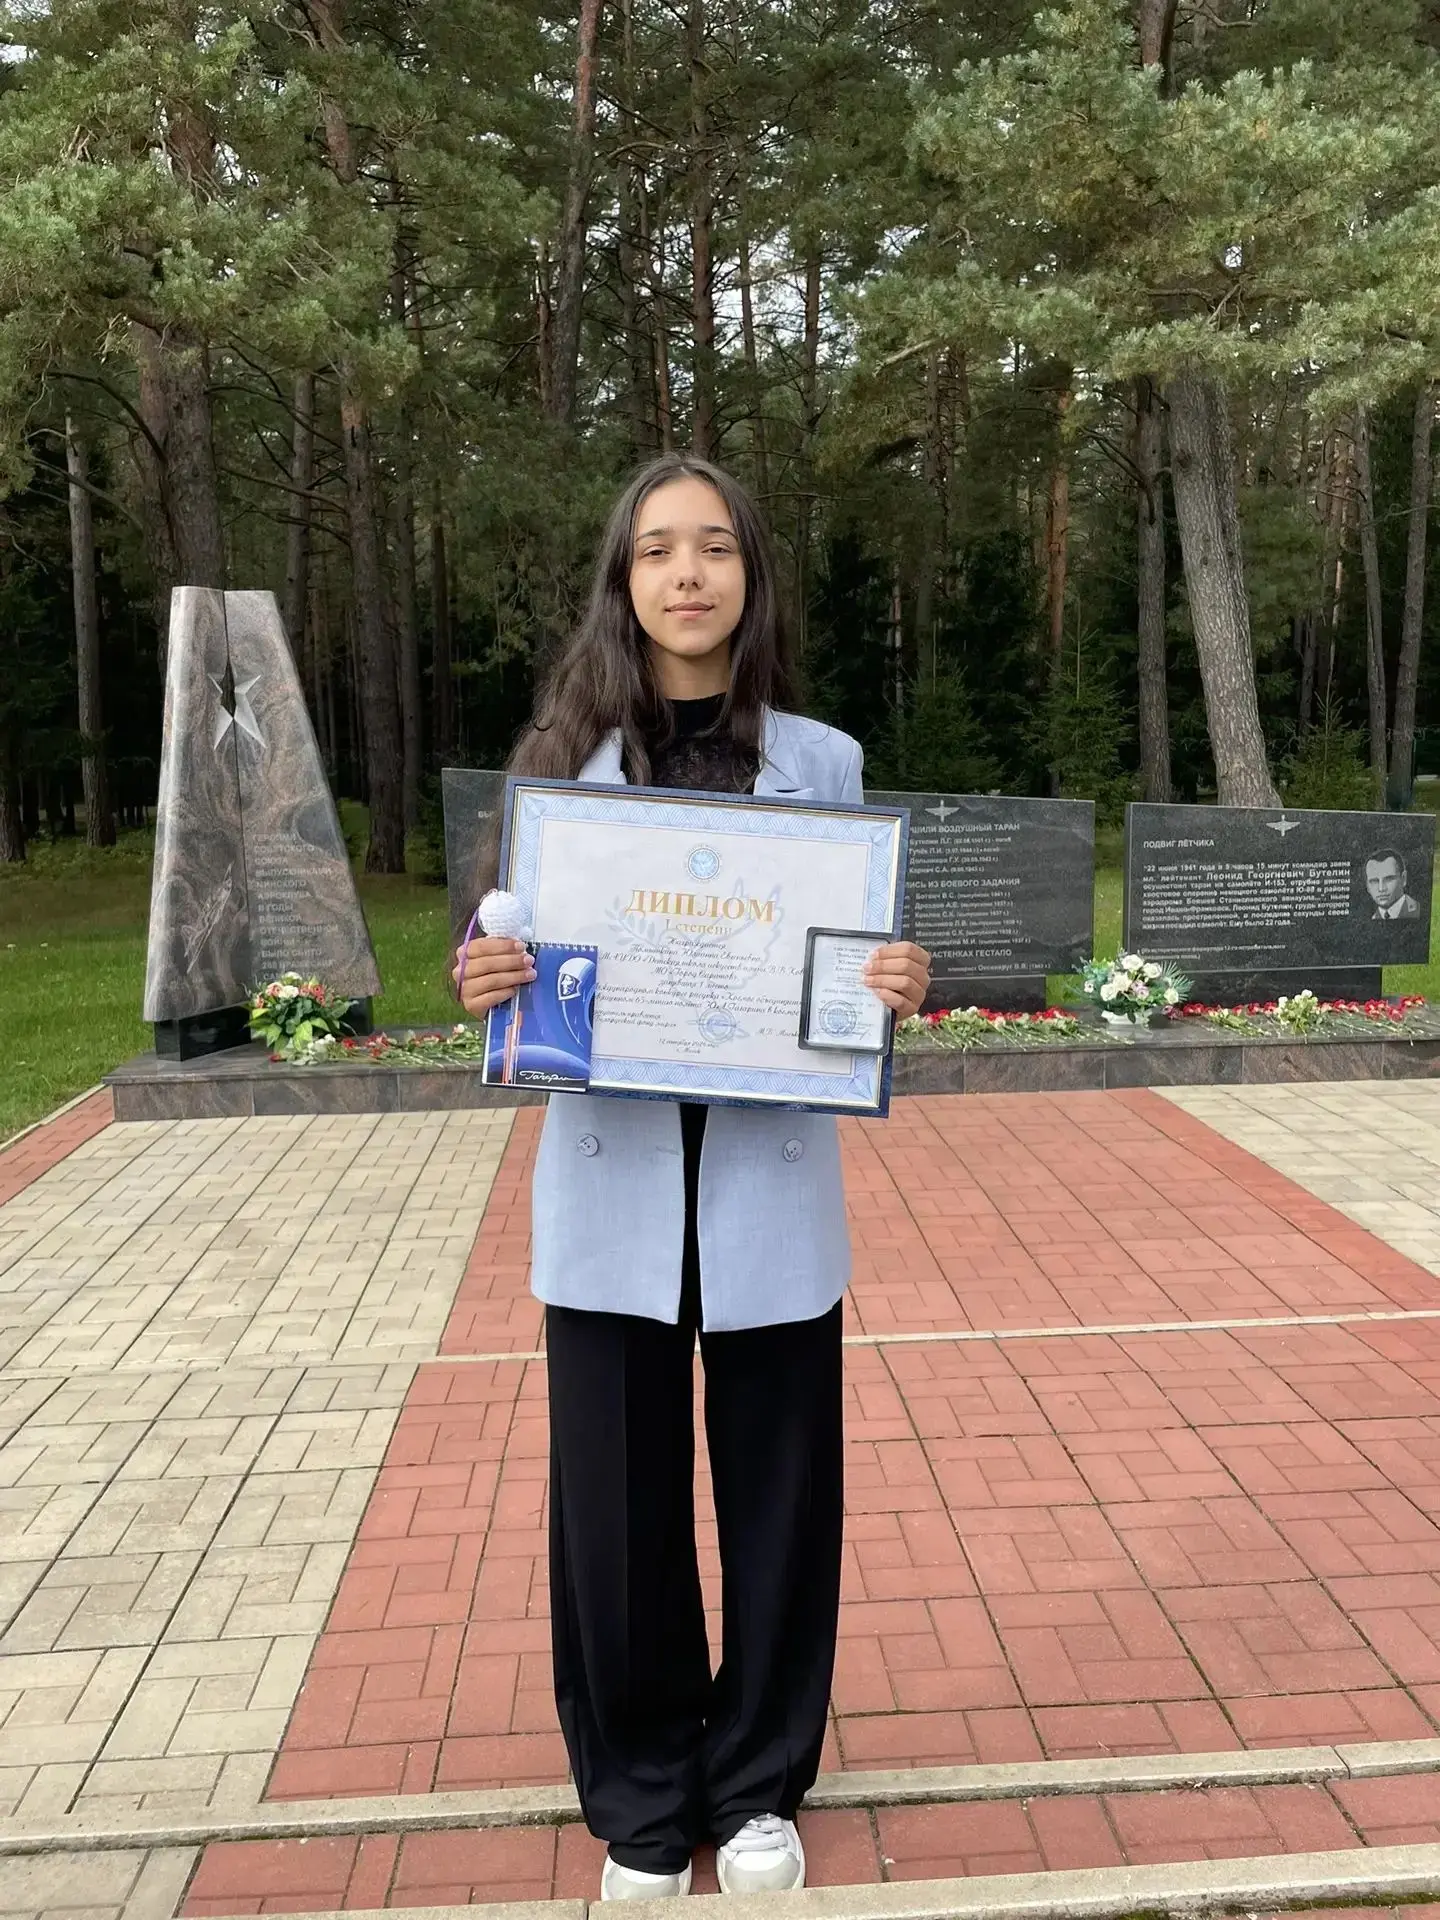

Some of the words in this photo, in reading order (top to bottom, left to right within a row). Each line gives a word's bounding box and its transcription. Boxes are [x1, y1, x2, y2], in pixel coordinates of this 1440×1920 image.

[938, 824, 993, 833] ВОЗДУШНЫЙ
[994, 822, 1020, 831] ТАРАН
[1143, 840, 1177, 849] ПОДВИГ
[1178, 838, 1215, 848] ЛЁТЧИКА
[1206, 871, 1244, 881] Леонид
[1248, 870, 1304, 879] Георгиевич
[1309, 868, 1350, 878] Бутелин
[941, 880, 980, 888] БОЕВОГО
[981, 878, 1020, 887] ЗАДАНИЯ
[1219, 888, 1258, 896] немецкого
[1324, 884, 1350, 894] районе
[1219, 896, 1278, 904] Станиславского
[267, 903, 293, 913] ГОДЫ
[624, 889, 777, 923] ДИПЛОМ
[1293, 910, 1325, 918] секунды
[1328, 908, 1350, 916] своей
[1229, 919, 1243, 928] Ему
[1244, 918, 1265, 927] было
[1265, 918, 1274, 926] 22
[675, 923, 732, 936] степени
[976, 949, 1012, 957] ГЕСТАПО
[728, 1002, 766, 1013] Гагарина
